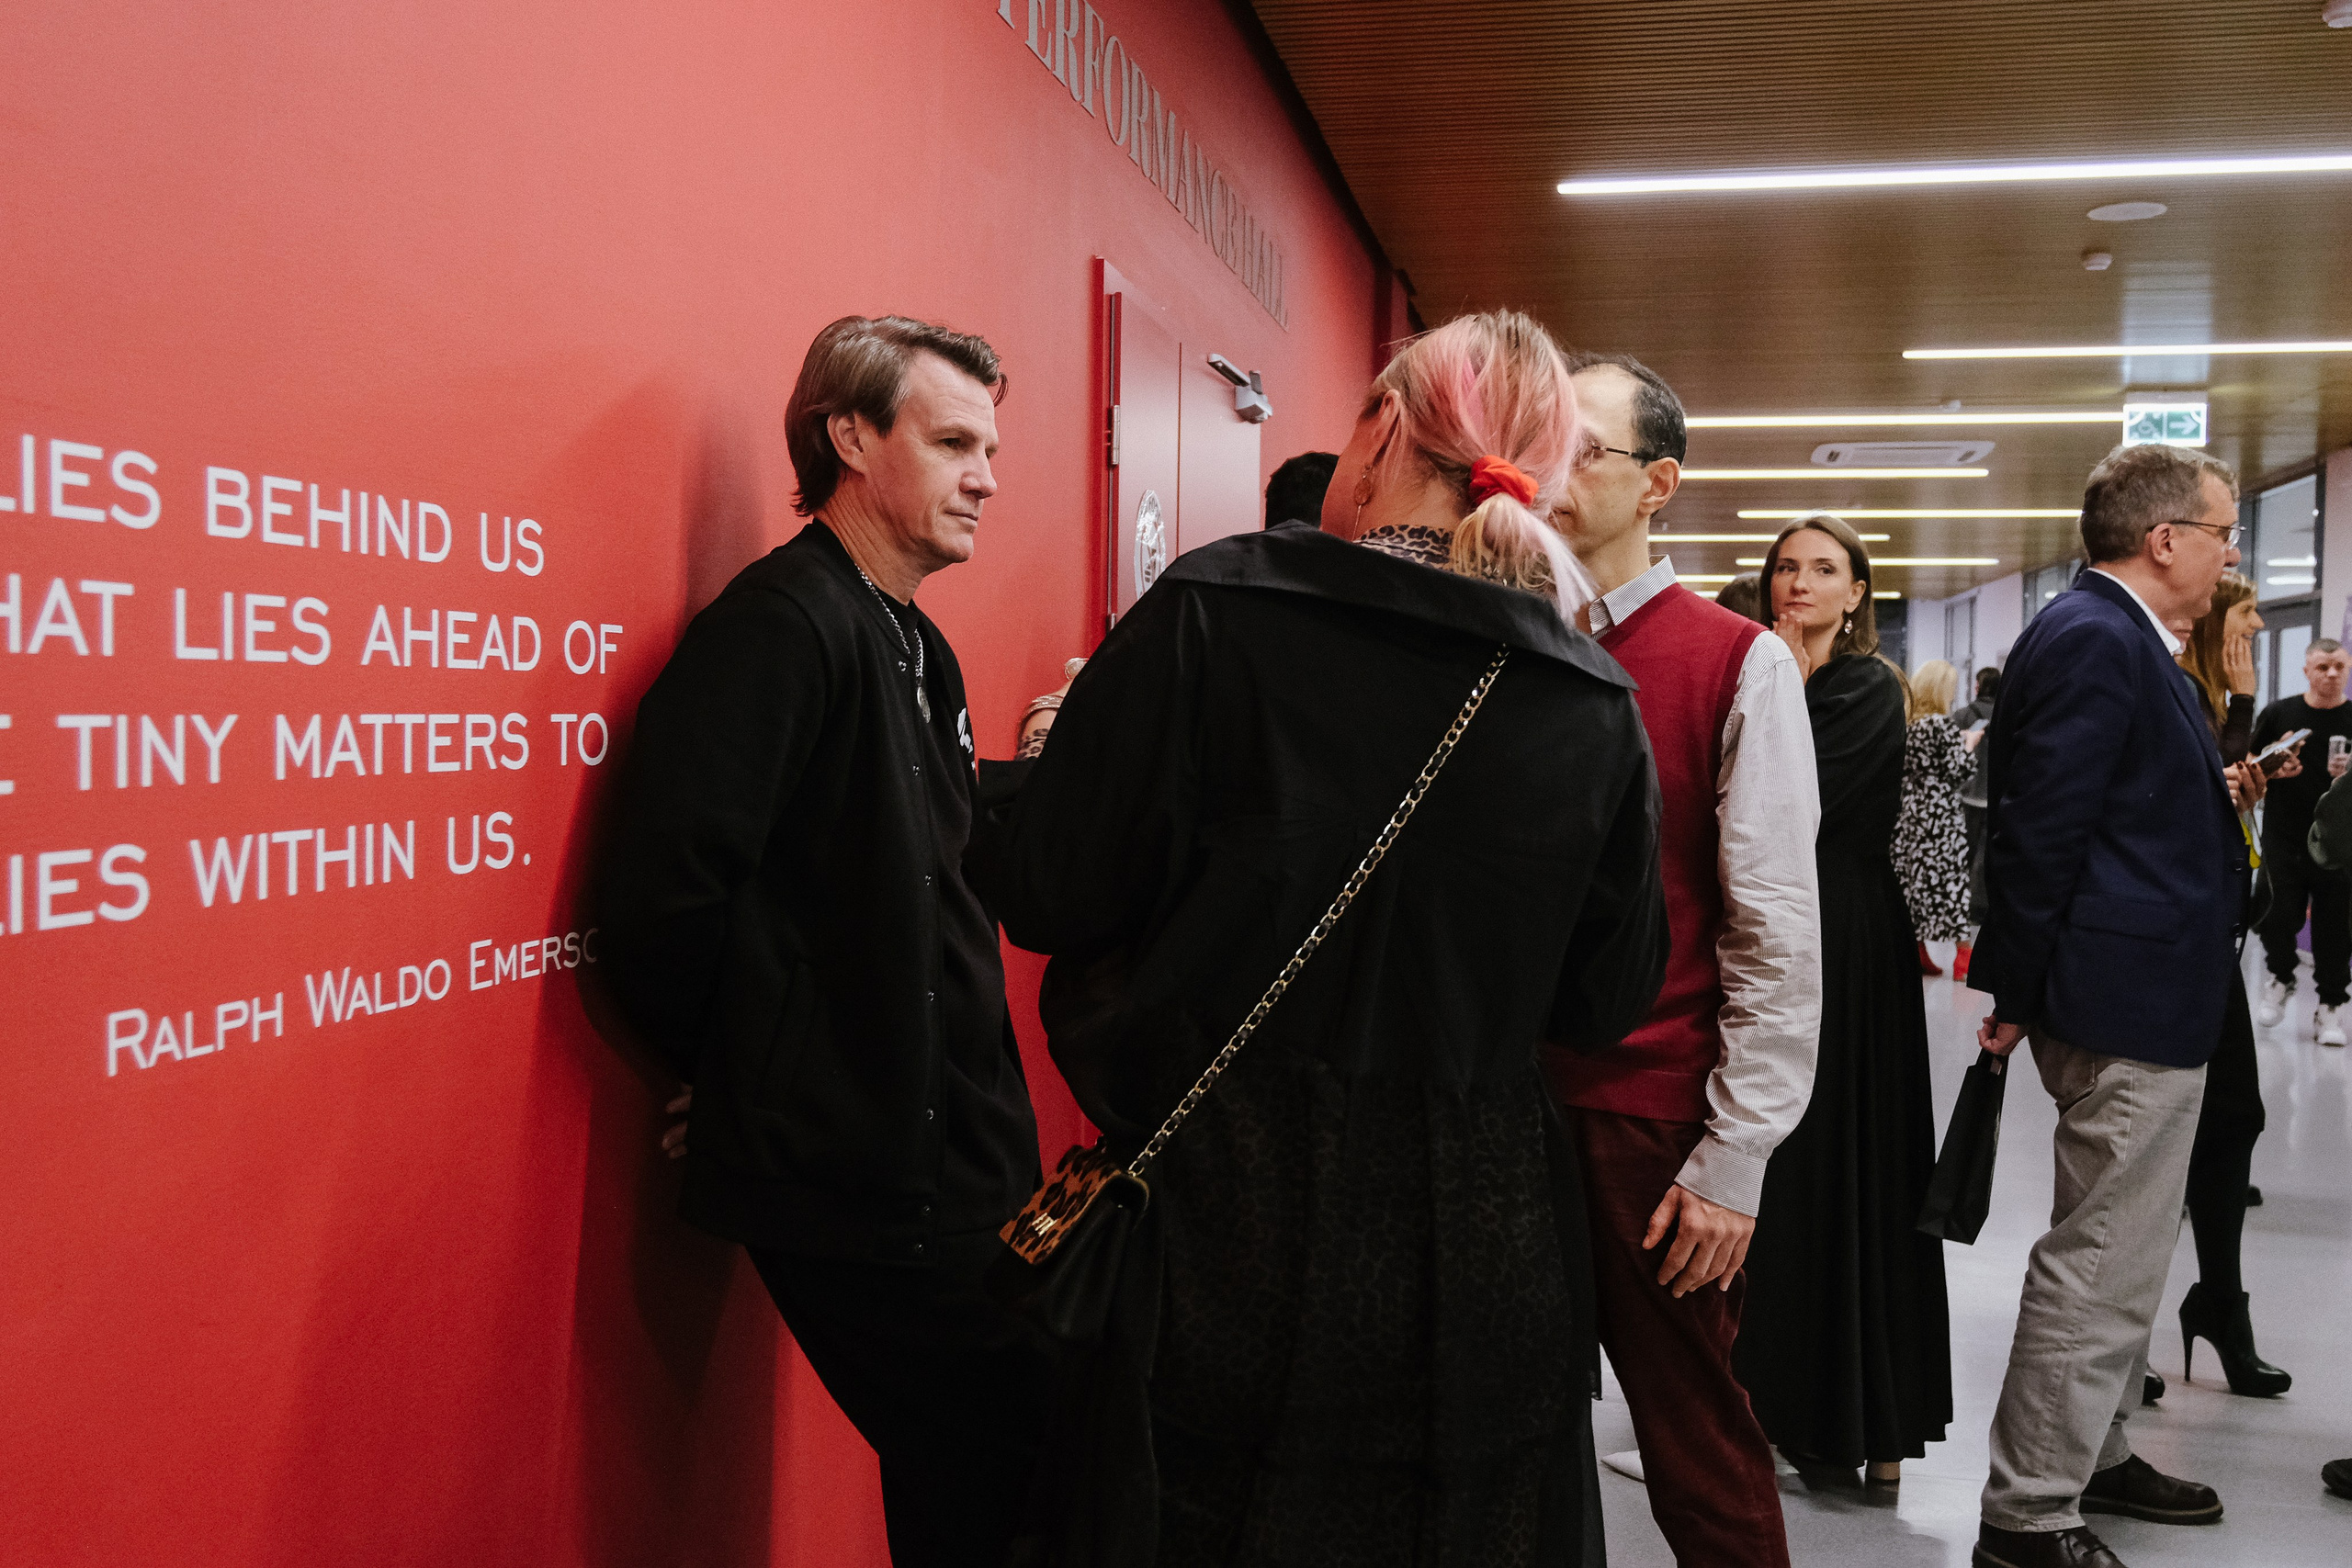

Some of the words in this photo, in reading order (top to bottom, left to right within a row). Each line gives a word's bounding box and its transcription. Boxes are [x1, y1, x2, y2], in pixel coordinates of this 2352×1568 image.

[997, 0, 1238, 275] ERFORMANCE
[206, 466, 452, 562] BEHIND
[481, 513, 544, 576] US
[175, 588, 331, 665] LIES
[361, 604, 541, 671] AHEAD
[564, 620, 623, 674] OF
[57, 715, 238, 790] TINY
[276, 713, 529, 780] MATTERS
[551, 713, 607, 765] TO
[0, 844, 150, 936] IES
[189, 820, 414, 907] WITHIN
[448, 811, 530, 874] US.
[107, 993, 283, 1077] RALPH
[305, 959, 451, 1027] WALDO
